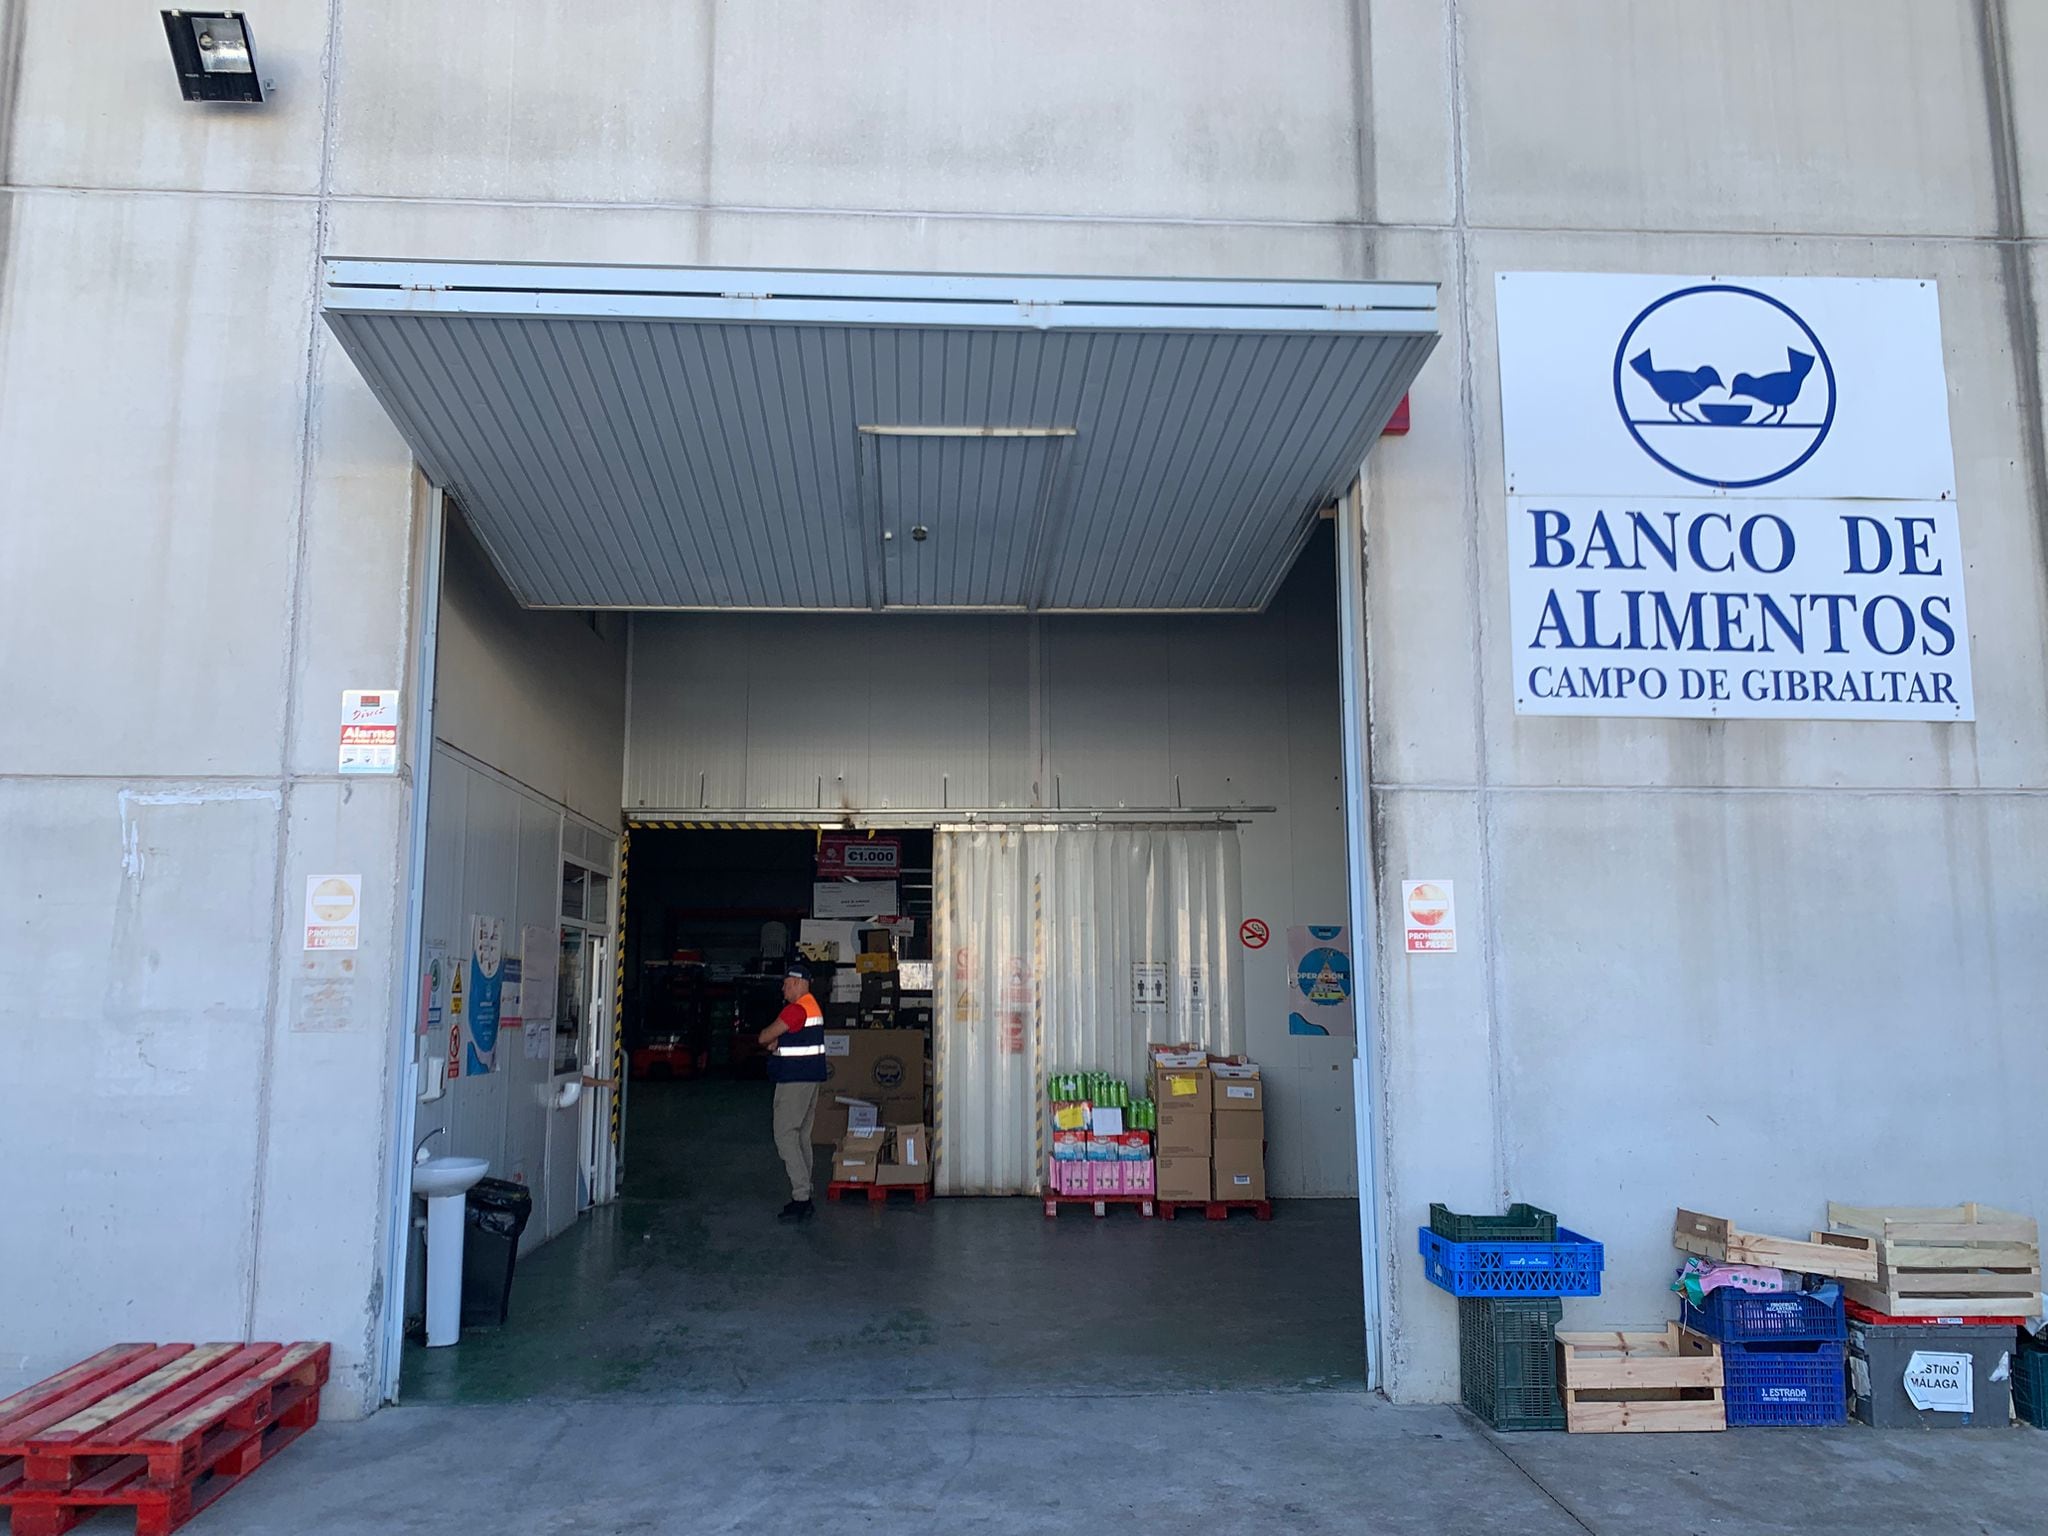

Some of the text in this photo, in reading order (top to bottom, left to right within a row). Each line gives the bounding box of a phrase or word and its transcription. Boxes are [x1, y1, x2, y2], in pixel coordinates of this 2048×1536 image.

[1526, 509, 1943, 576] BANCO DE
[1528, 588, 1956, 656] ALIMENTOS
[1528, 666, 1959, 704] CAMPO DE GIBRALTAR
[342, 727, 396, 739] Alarma
[848, 851, 894, 862] €1.000
[1415, 940, 1448, 948] EL PASO
[1761, 1387, 1807, 1397] J. ESTRADA
